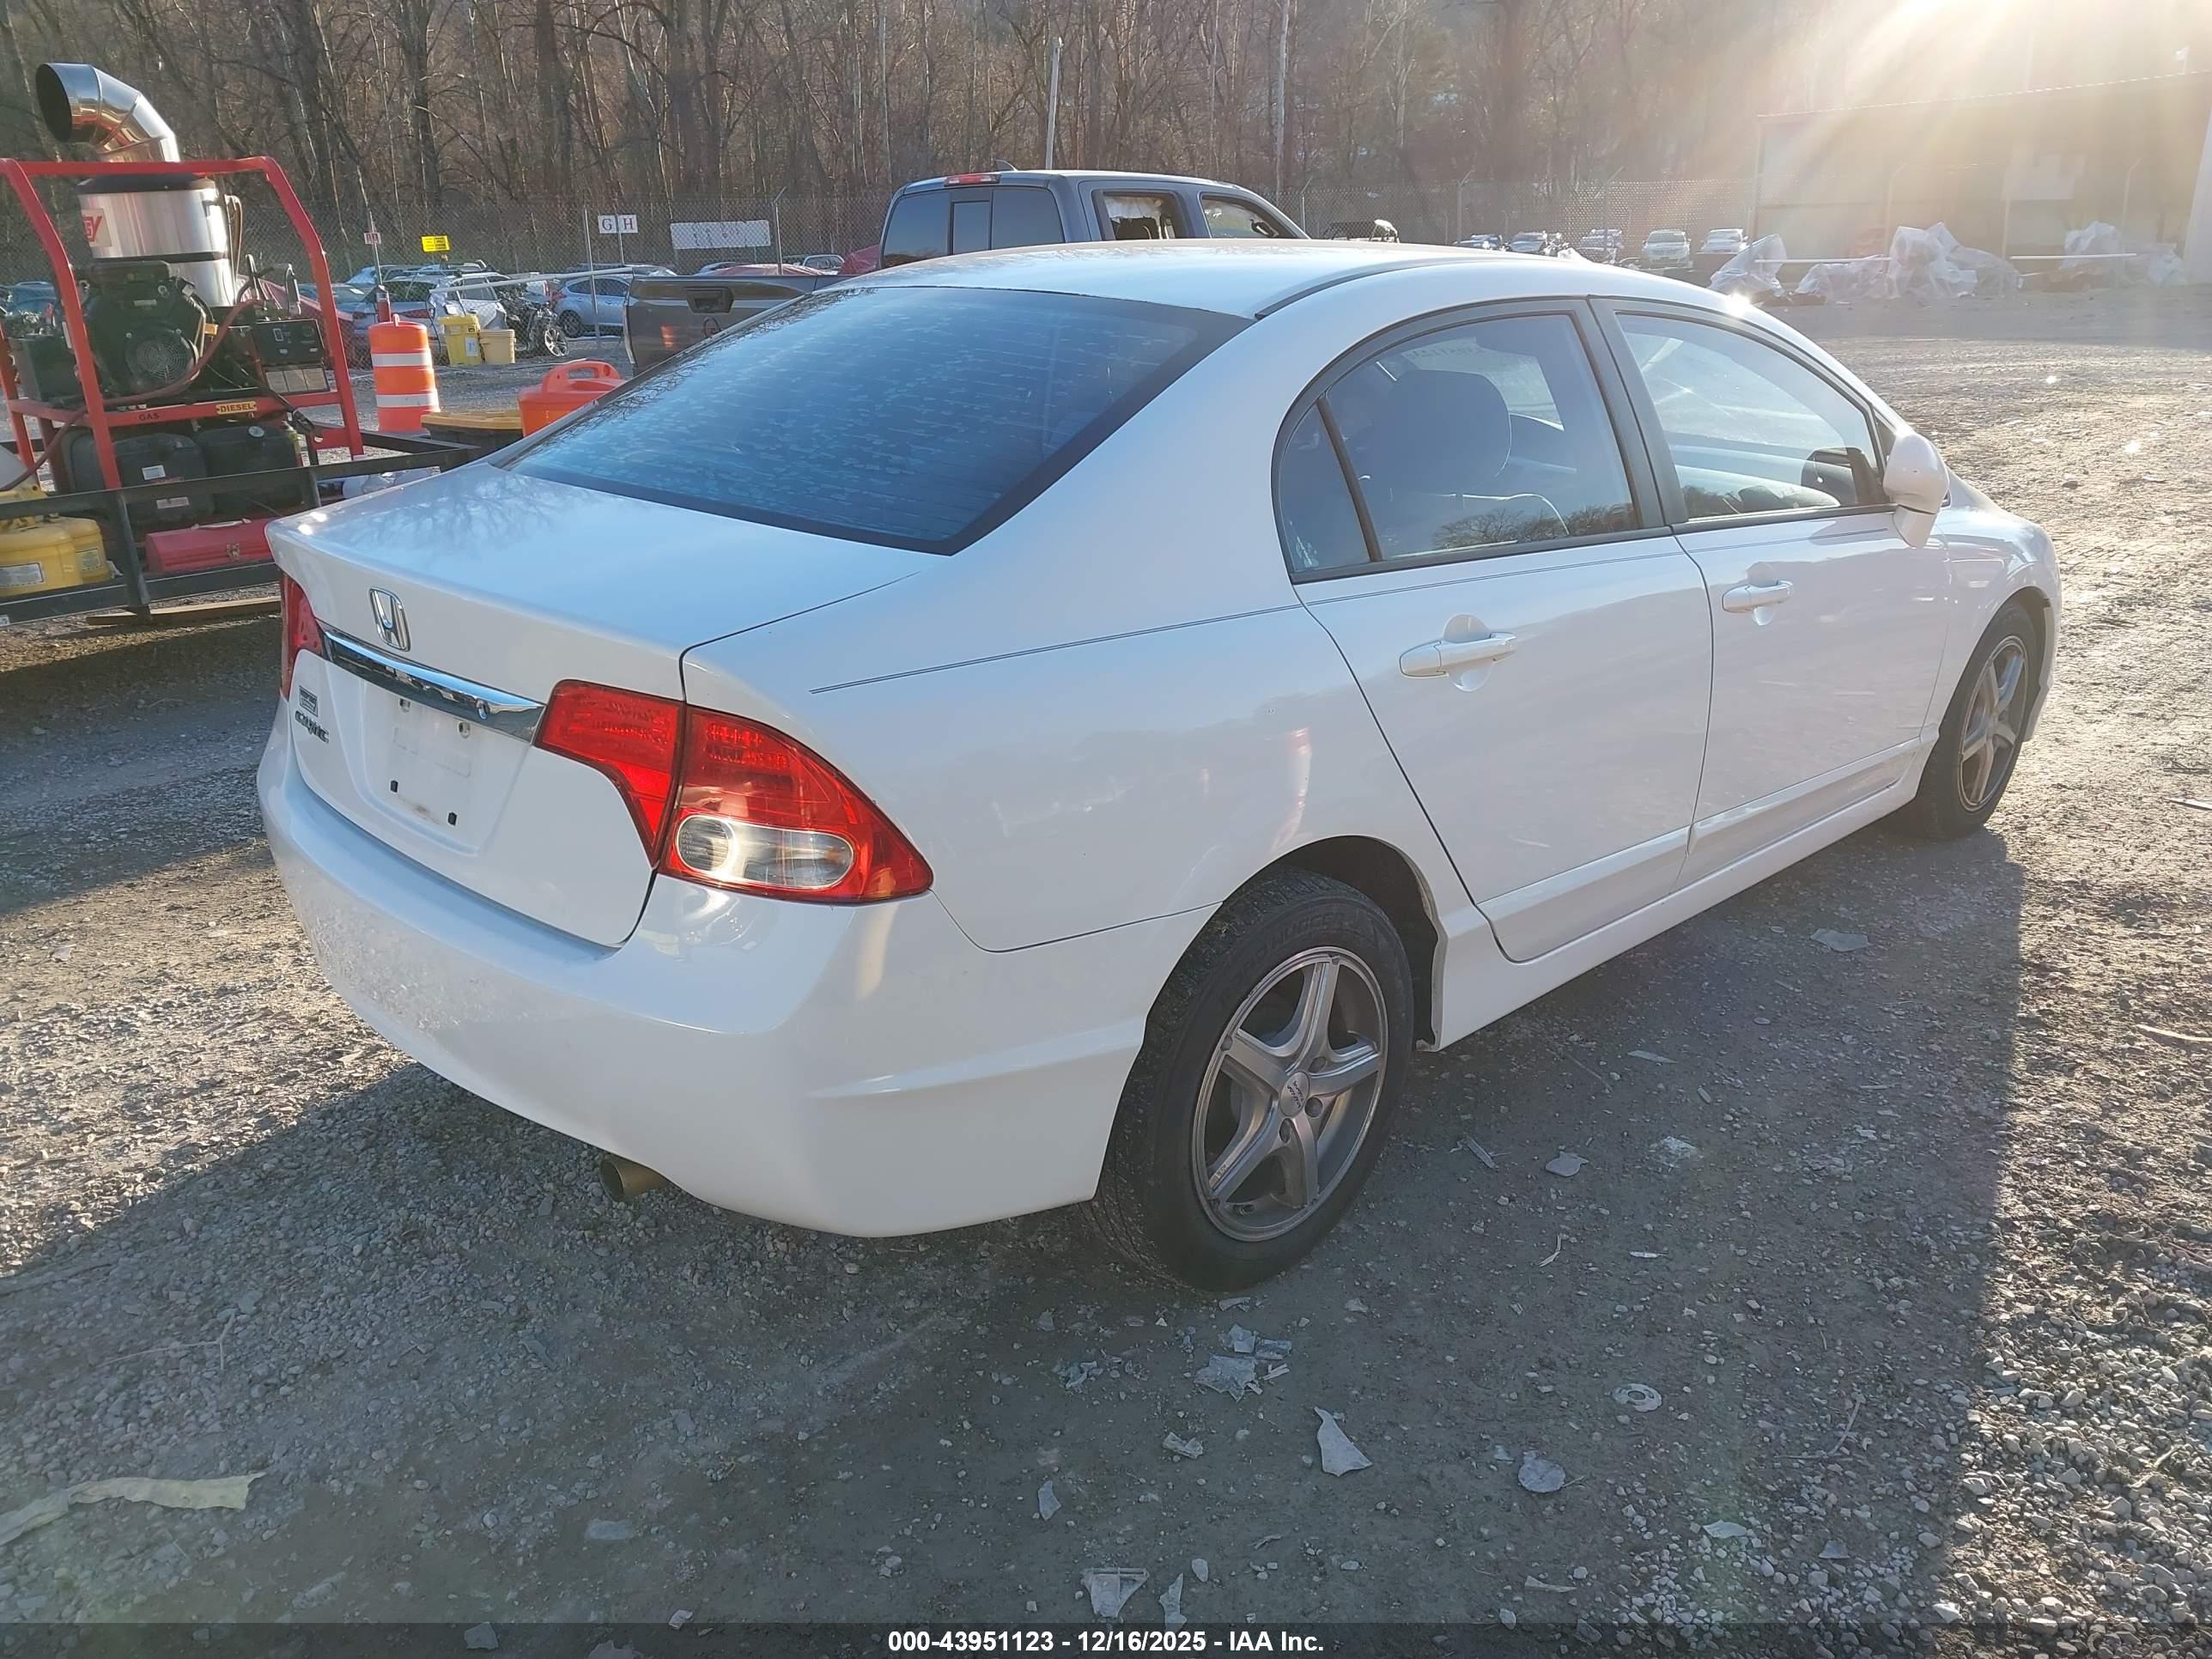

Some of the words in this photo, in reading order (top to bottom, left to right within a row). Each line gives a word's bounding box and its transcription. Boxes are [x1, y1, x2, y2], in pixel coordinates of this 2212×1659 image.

[602, 218, 612, 230] G
[623, 218, 634, 229] H
[220, 404, 253, 413] DIESEL
